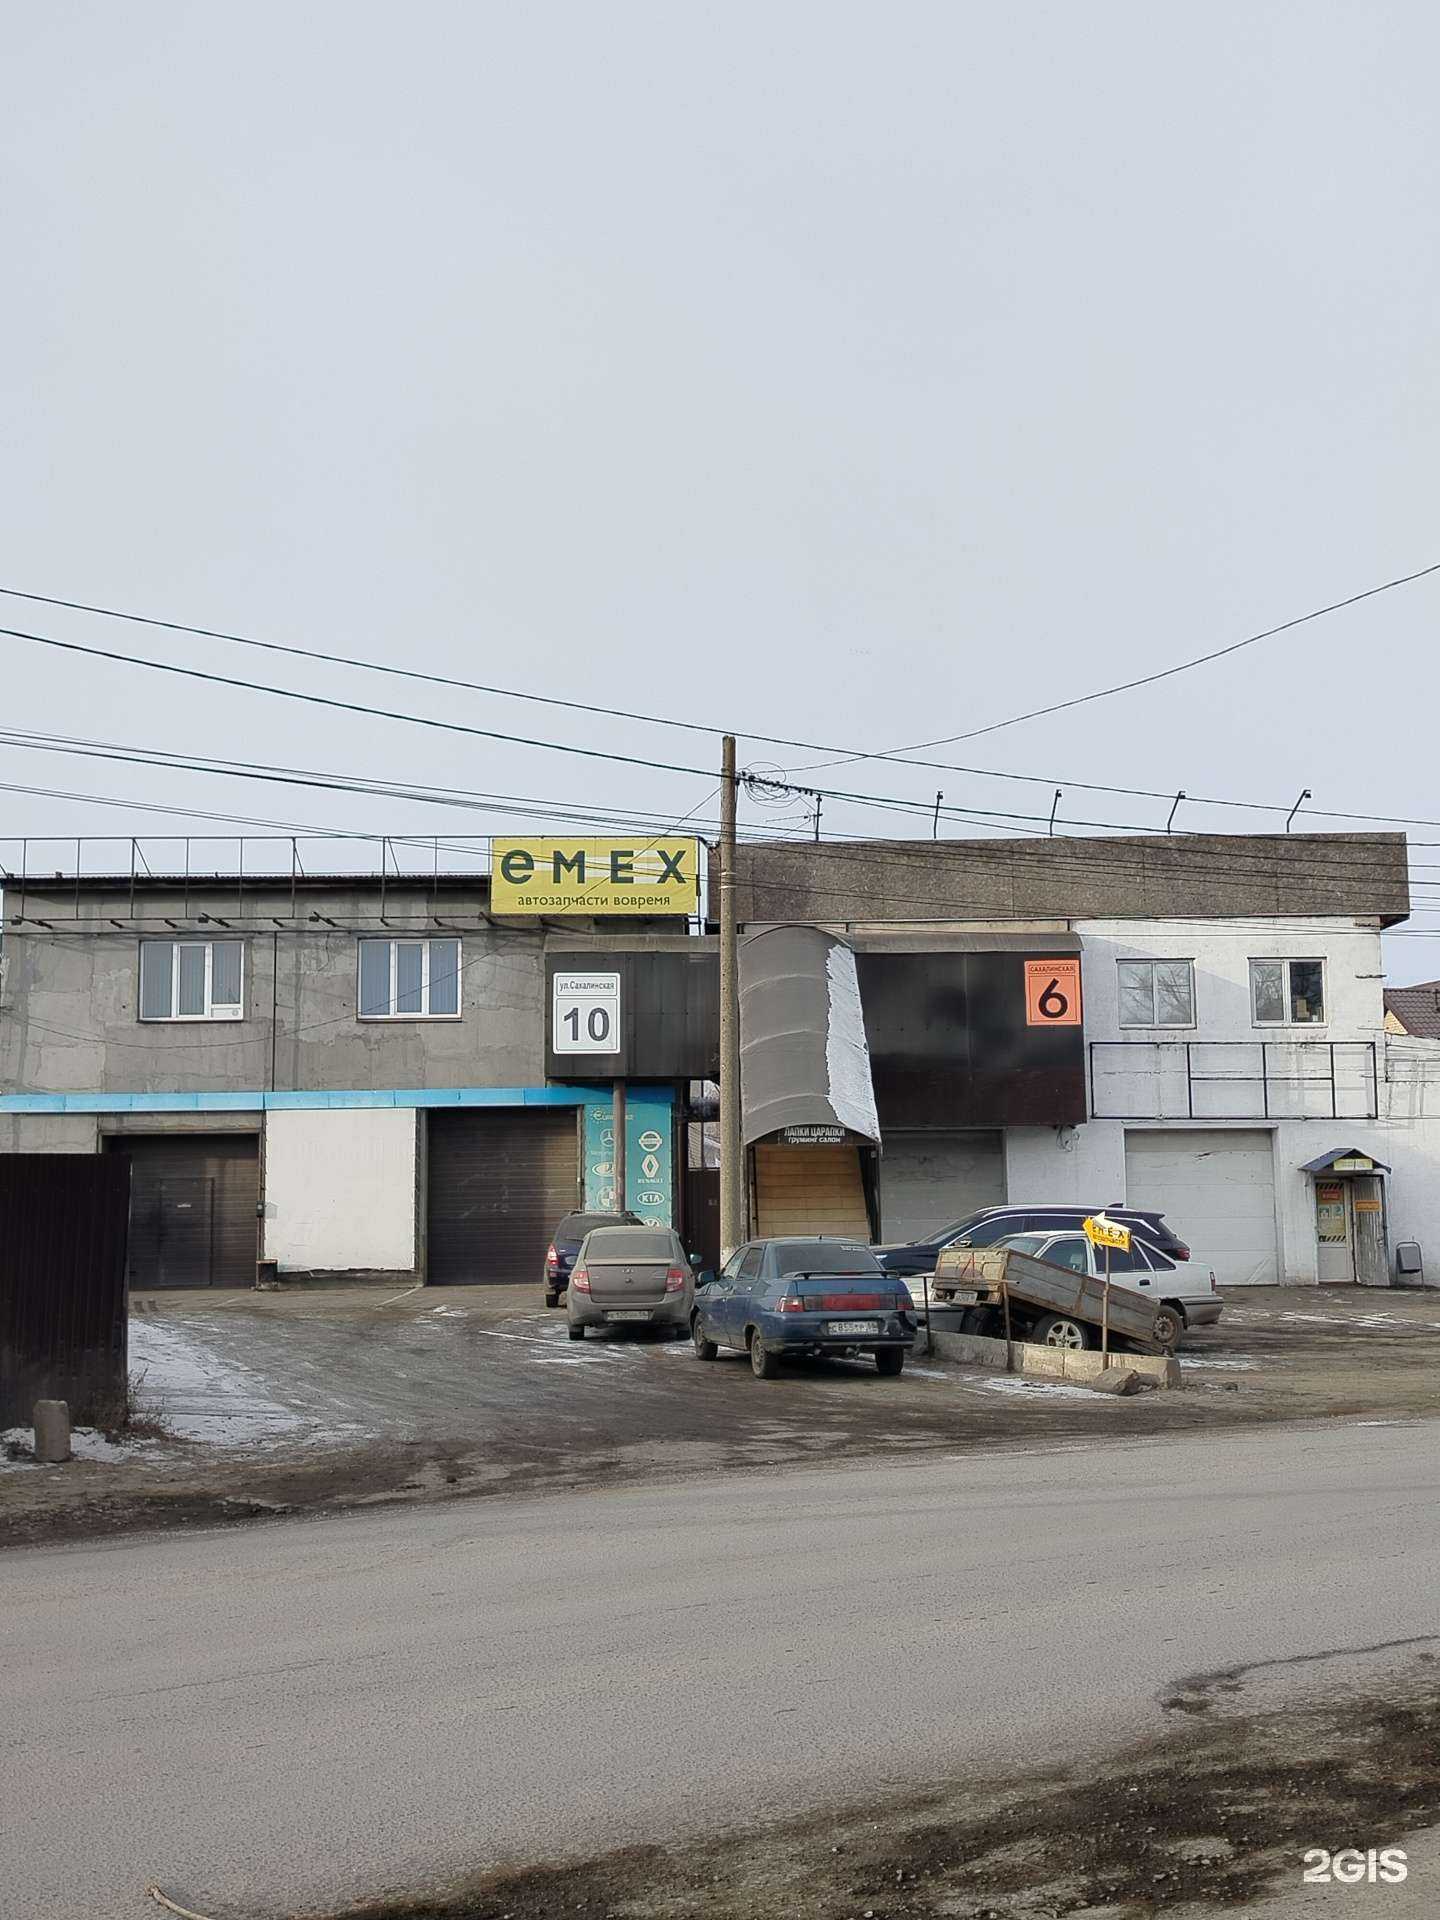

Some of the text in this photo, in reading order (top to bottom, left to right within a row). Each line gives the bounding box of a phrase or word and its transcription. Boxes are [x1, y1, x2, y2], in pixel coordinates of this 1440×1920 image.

[518, 895, 670, 908] автозапчасти вовремя
[1038, 977, 1068, 1019] 6
[563, 1007, 610, 1041] 10
[784, 1126, 846, 1137] ЛАПКИ ЦАРАПКИ
[788, 1136, 818, 1144] груминг
[641, 1194, 660, 1203] KIA
